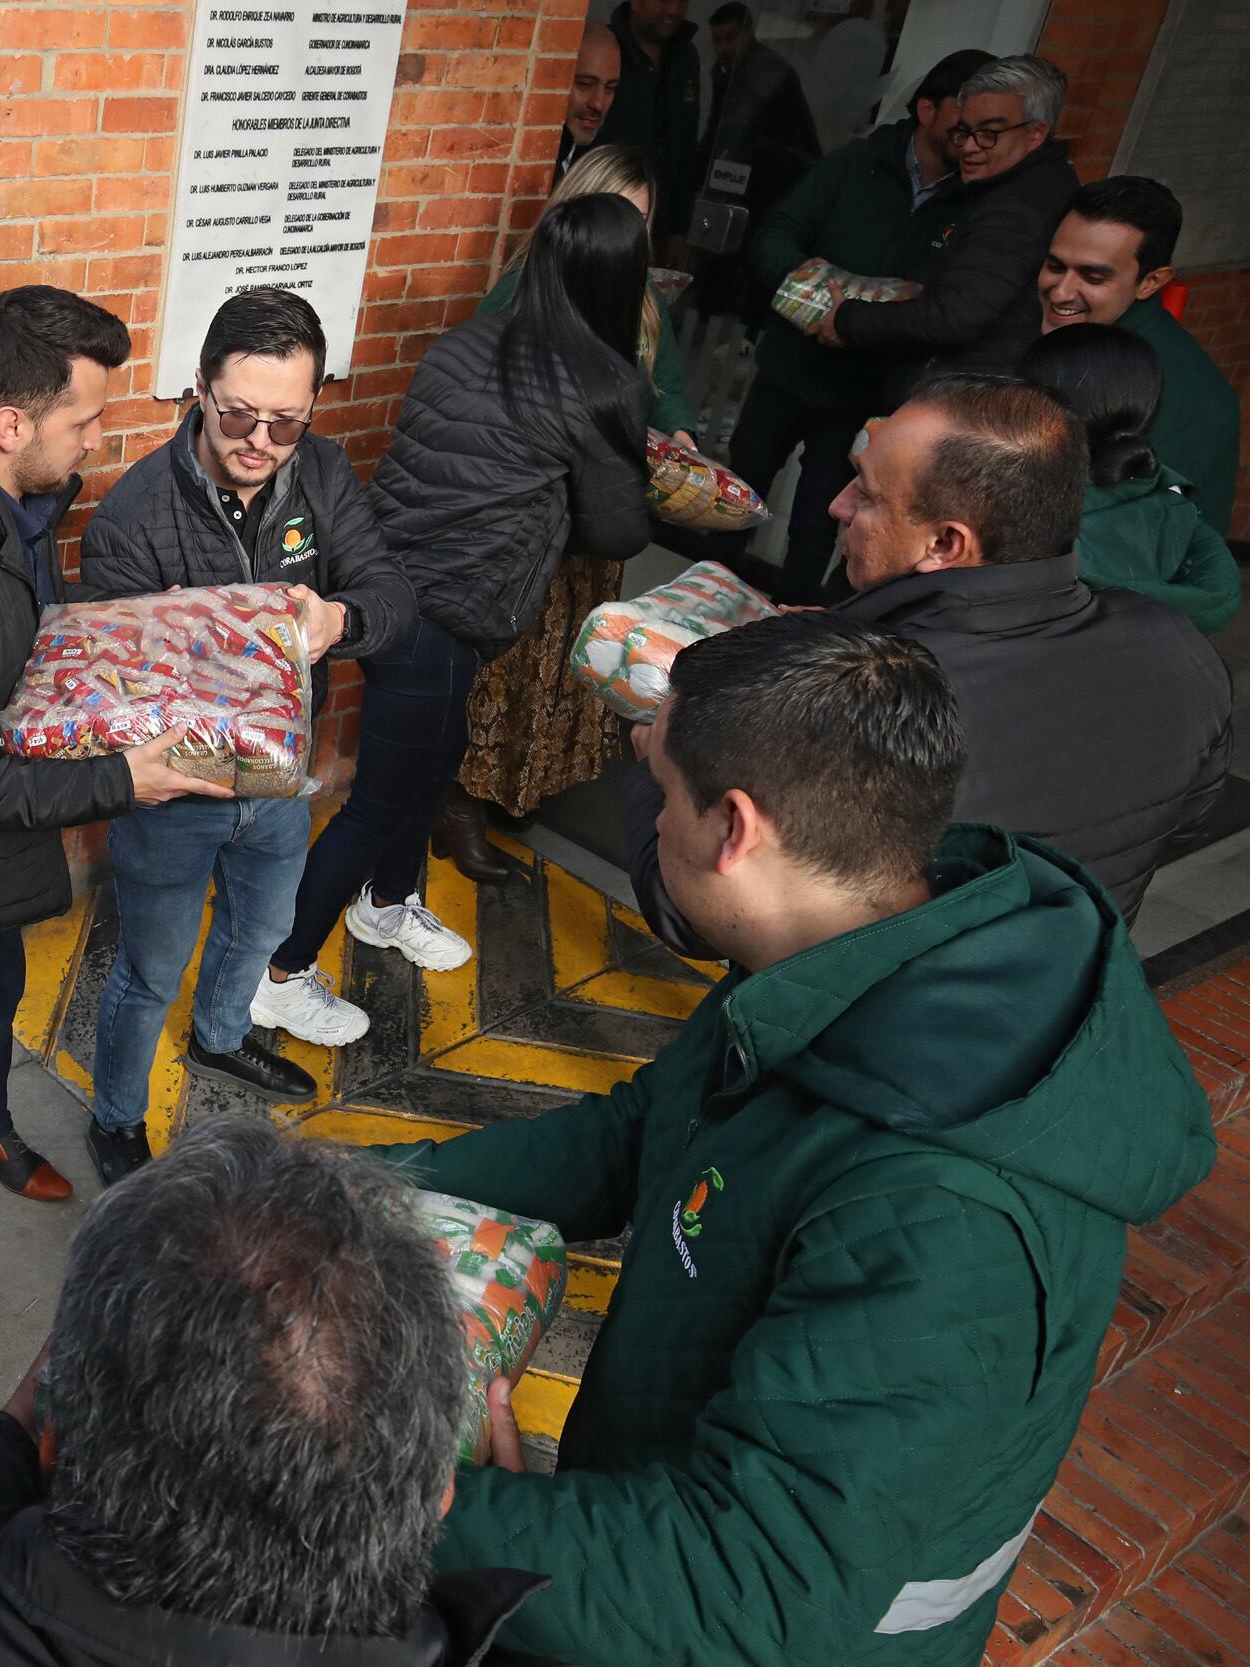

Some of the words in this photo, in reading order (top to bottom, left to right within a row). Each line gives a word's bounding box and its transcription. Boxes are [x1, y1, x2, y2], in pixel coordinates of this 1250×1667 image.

[219, 10, 242, 21] RODOLFO
[242, 11, 263, 21] ENRIQUE
[273, 11, 295, 22] NAVARRO
[330, 13, 337, 23] DE
[336, 13, 362, 23] AGRICULTURA
[365, 14, 390, 24] DESARROLLO
[216, 36, 236, 48] NICOLÁS
[254, 38, 273, 48] BUSTOS
[309, 39, 335, 49] GOBERNADOR
[335, 39, 341, 49] DE
[216, 64, 236, 75] CLAUDIA
[236, 63, 252, 75] LÓPEZ
[251, 63, 280, 75] HERNÁNDEZ
[340, 65, 346, 75] DE
[210, 91, 237, 102] FRANCISCO
[237, 91, 252, 101] JAVIER
[253, 91, 274, 101] SALCEDO
[337, 91, 343, 101] DE
[232, 118, 267, 131] HONORABLES
[267, 118, 295, 130] MIEMBROS
[295, 118, 302, 130] DE
[302, 117, 309, 129] LA
[309, 117, 325, 129] JUNTA
[325, 117, 350, 129] DIRECTIVA
[203, 150, 214, 159] LUIS
[214, 149, 231, 158] JAVIER
[231, 149, 248, 158] PINILLA
[293, 148, 315, 157] DELEGADO
[315, 147, 323, 156] DEL
[323, 147, 346, 156] MINISTERIO
[346, 146, 352, 155] DE
[351, 146, 377, 155] AGRICULTURA
[292, 159, 318, 168] DESARROLLO
[318, 158, 331, 167] RURAL
[199, 185, 210, 194] LUIS
[210, 184, 236, 193] HUMBERTO
[257, 181, 279, 191] VERGARA
[289, 182, 310, 190] DELEGADO
[310, 181, 318, 189] DEL
[318, 180, 341, 189] MINISTERIO
[341, 179, 346, 188] DE
[346, 179, 373, 187] AGRICULTURA
[287, 192, 314, 201] DESARROLLO
[314, 191, 327, 200] RURAL
[195, 217, 212, 228] CÉSAR
[212, 217, 235, 226] AUGUSTO
[236, 216, 259, 225] CARRILLO
[259, 215, 271, 224] VEGA
[284, 214, 305, 223] DELEGADO
[306, 213, 312, 222] DE
[312, 213, 317, 222] LA
[345, 211, 351, 220] DE
[283, 224, 313, 234] CUNDINAMARCA
[280, 246, 301, 255] DELEGADO
[301, 245, 307, 254] DE
[343, 243, 349, 251] DE
[191, 252, 202, 261] LUIS
[202, 250, 230, 260] ALEJANDRO
[230, 249, 245, 258] PEREA
[268, 264, 290, 272] FRANCO
[297, 280, 313, 288] ORTIZ
